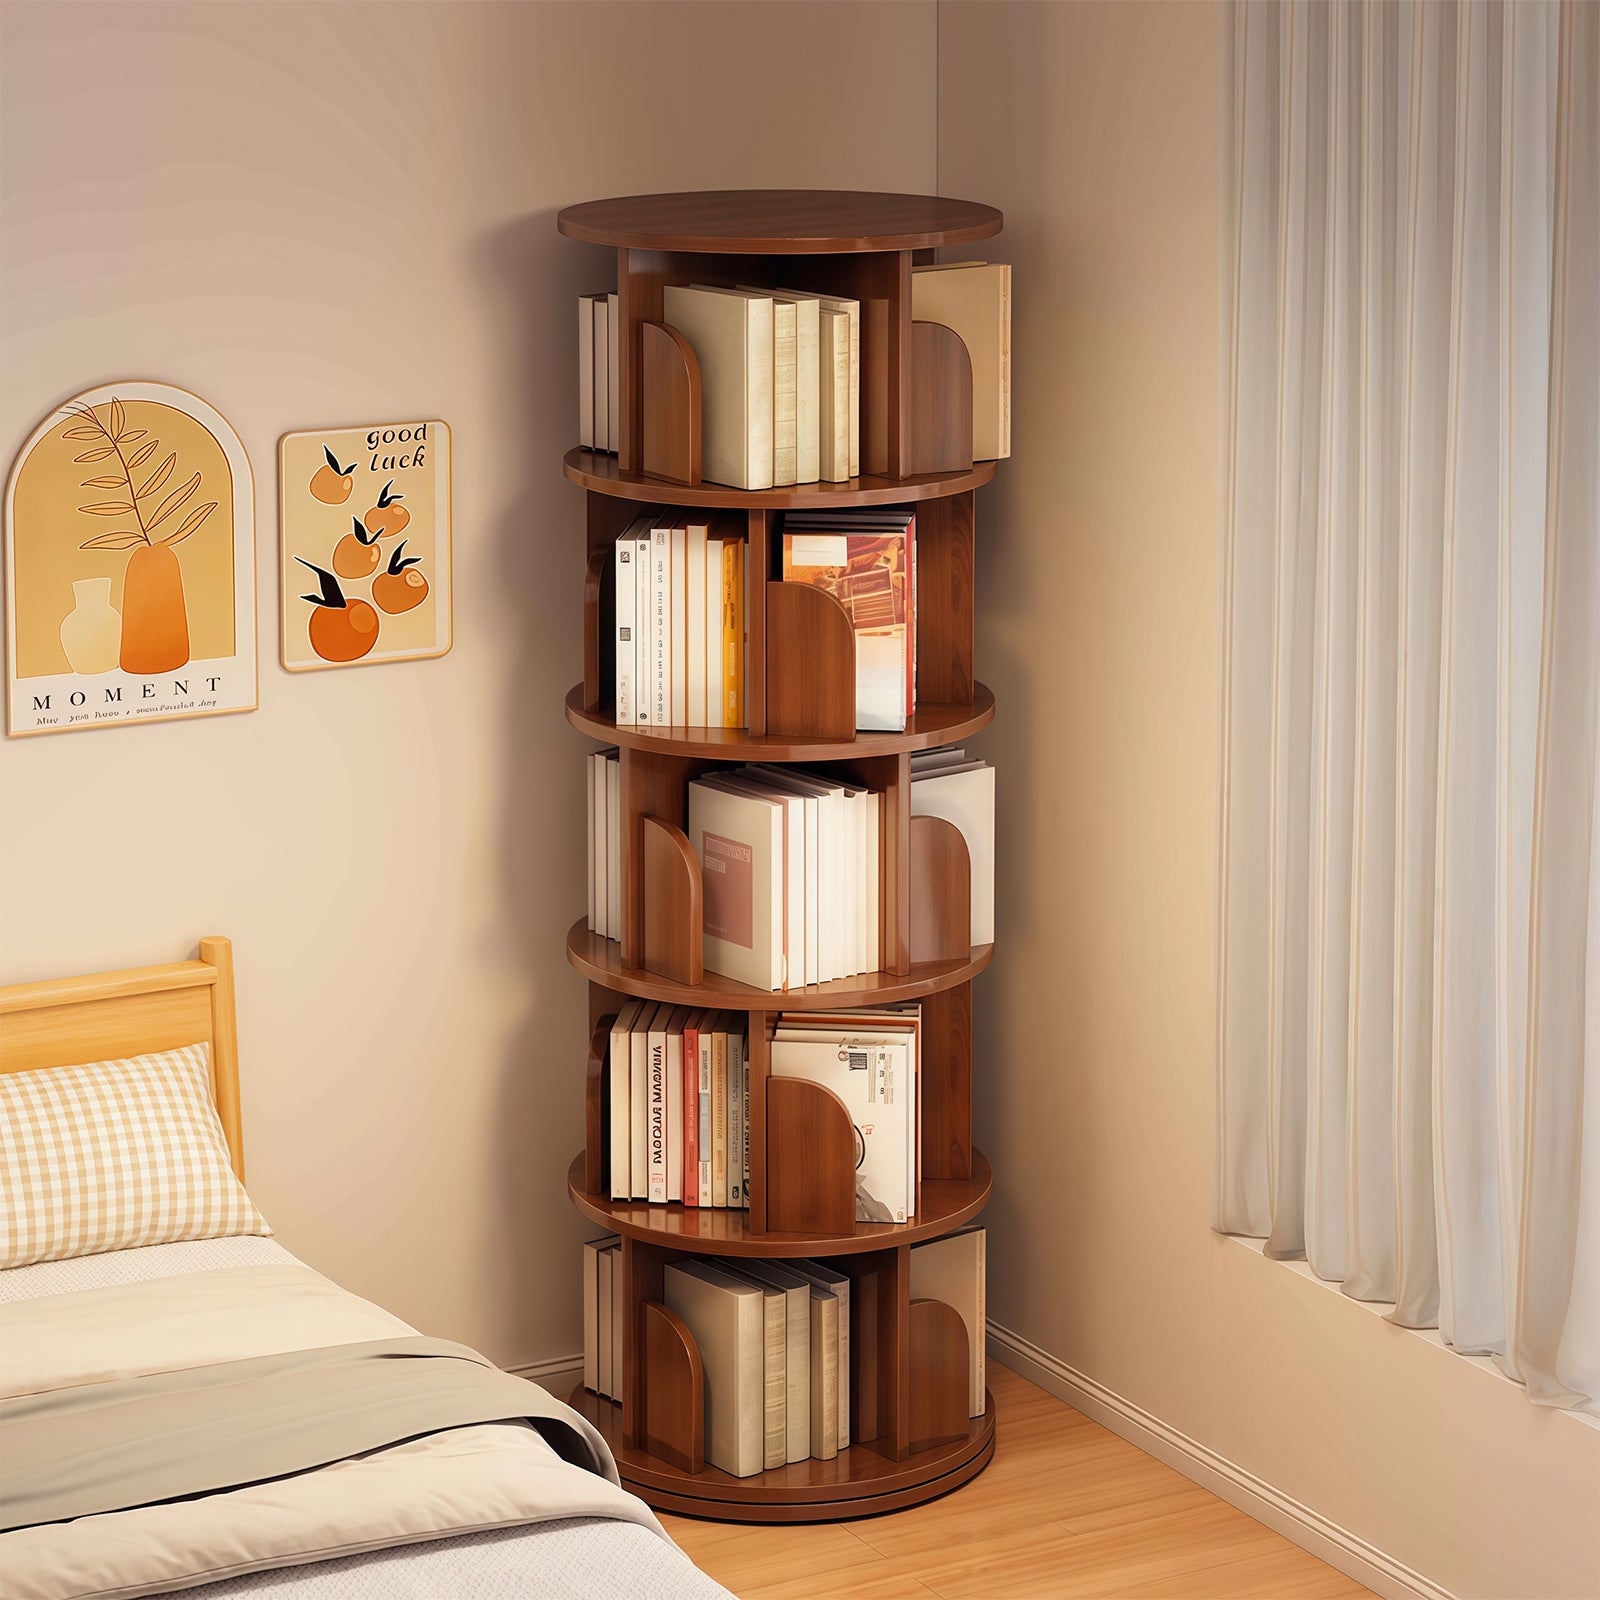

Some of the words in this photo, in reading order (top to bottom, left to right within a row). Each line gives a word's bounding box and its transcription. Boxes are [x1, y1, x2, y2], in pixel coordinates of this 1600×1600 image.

[366, 423, 427, 450] good
[370, 445, 425, 471] luck
[32, 677, 221, 710] MOMENT
